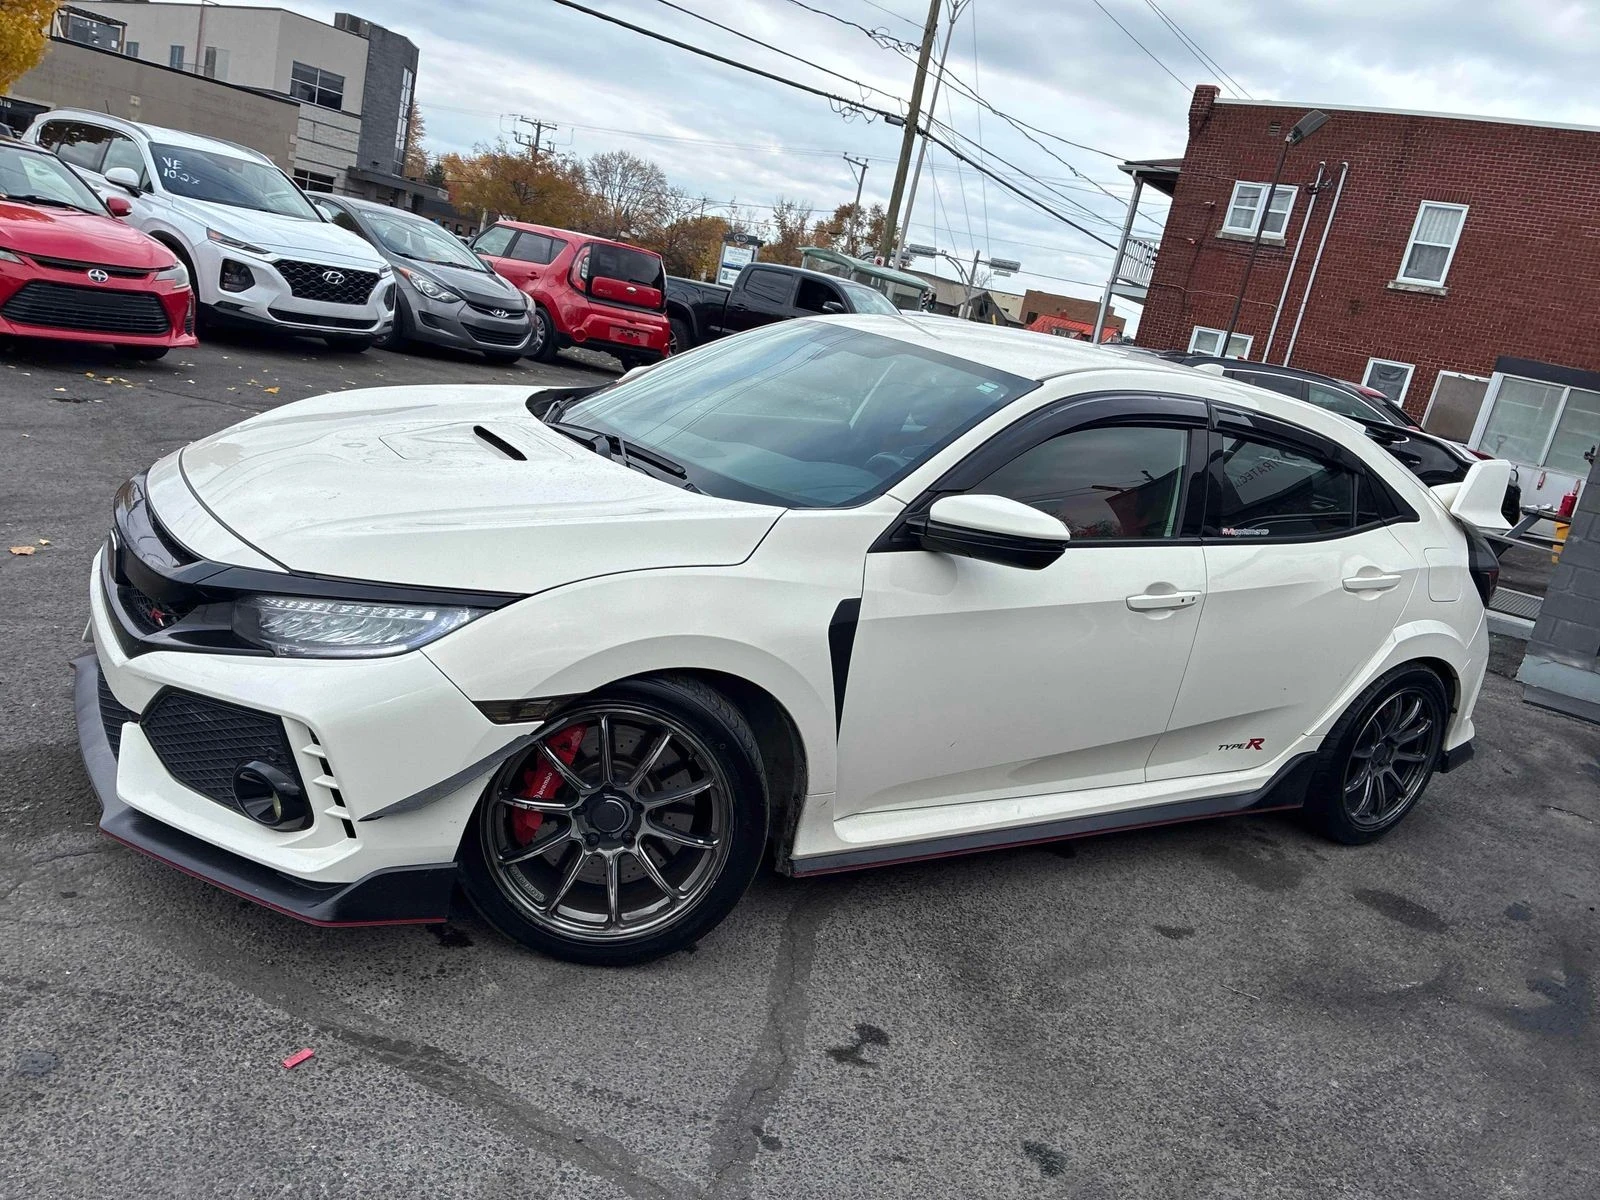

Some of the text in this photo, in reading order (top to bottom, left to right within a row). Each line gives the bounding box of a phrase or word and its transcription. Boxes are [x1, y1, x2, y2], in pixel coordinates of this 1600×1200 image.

[162, 156, 182, 170] VE
[1217, 737, 1266, 751] TYPE R
[536, 772, 553, 796] brembo
